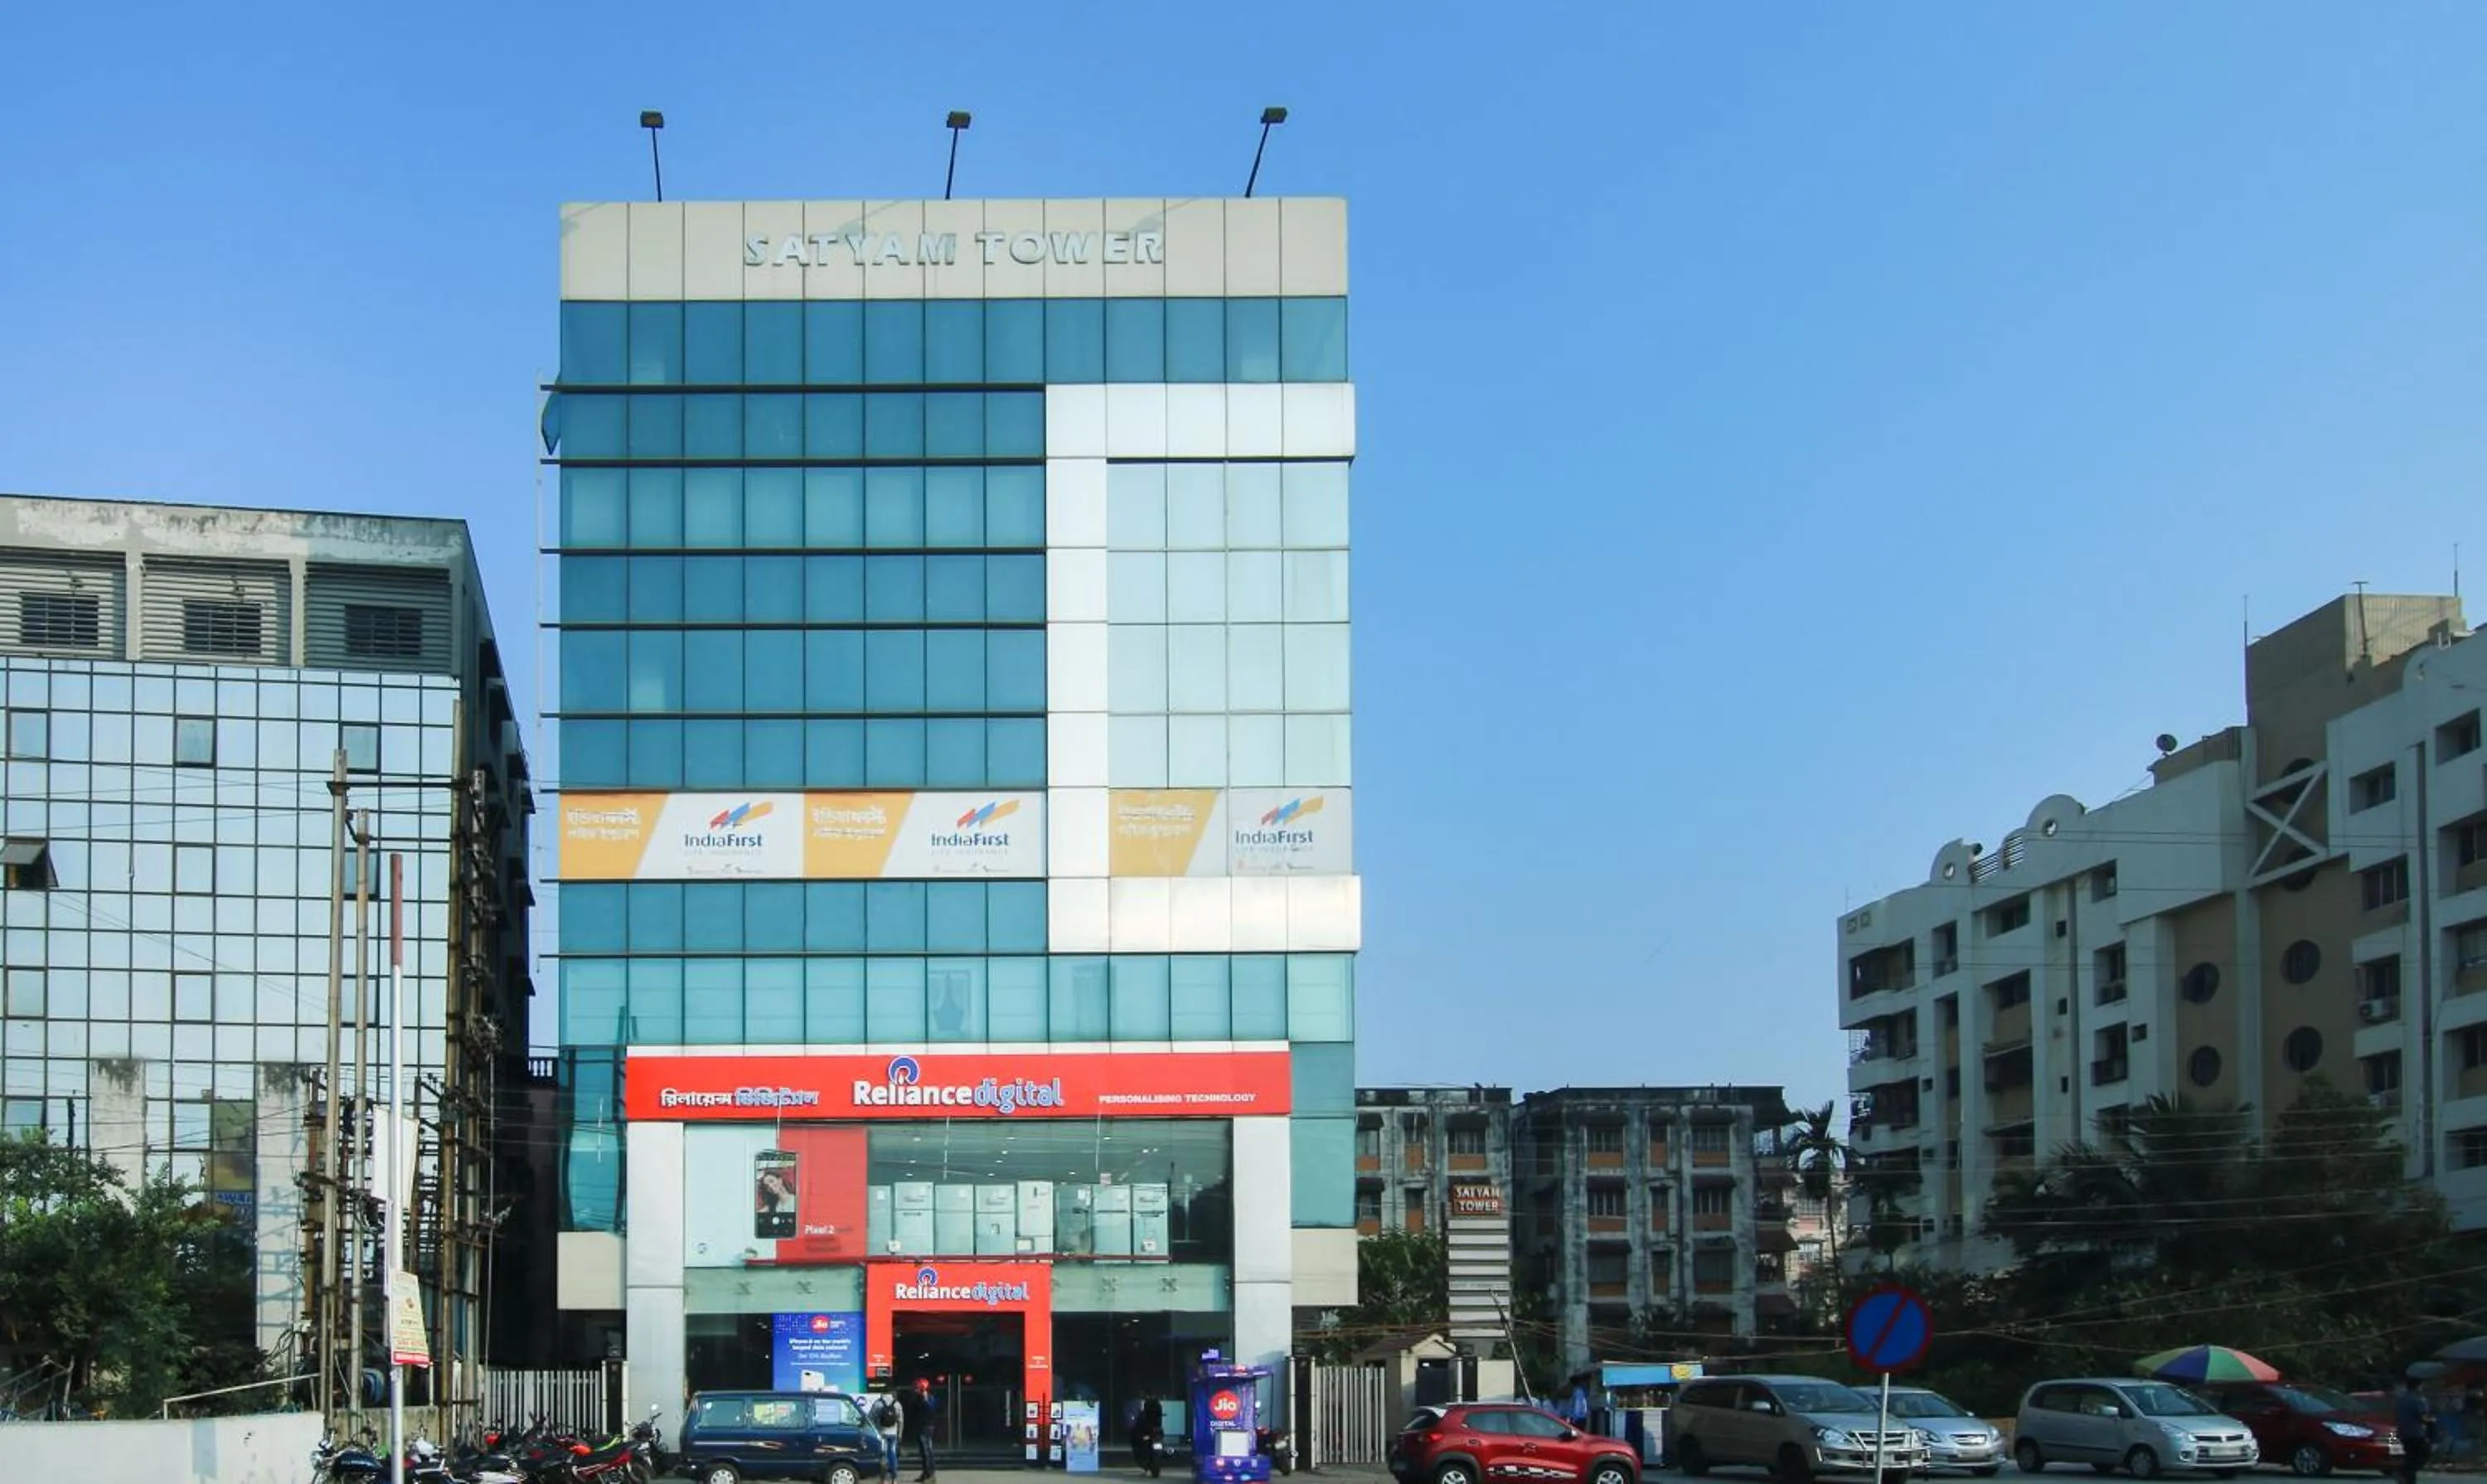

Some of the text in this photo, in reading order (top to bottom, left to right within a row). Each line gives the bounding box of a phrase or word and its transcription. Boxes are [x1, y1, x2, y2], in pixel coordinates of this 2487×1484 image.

[744, 231, 1164, 266] SATYAM TOWER
[684, 833, 763, 847] IndiaFirst
[931, 832, 1010, 846] IndiaFirst
[1235, 830, 1313, 844] IndiaFirst
[1185, 1093, 1256, 1103] TECHNOLOGY
[1459, 1200, 1499, 1211] TOWER
[804, 1225, 835, 1234] Pixel 2
[1214, 1398, 1237, 1411] Jio
